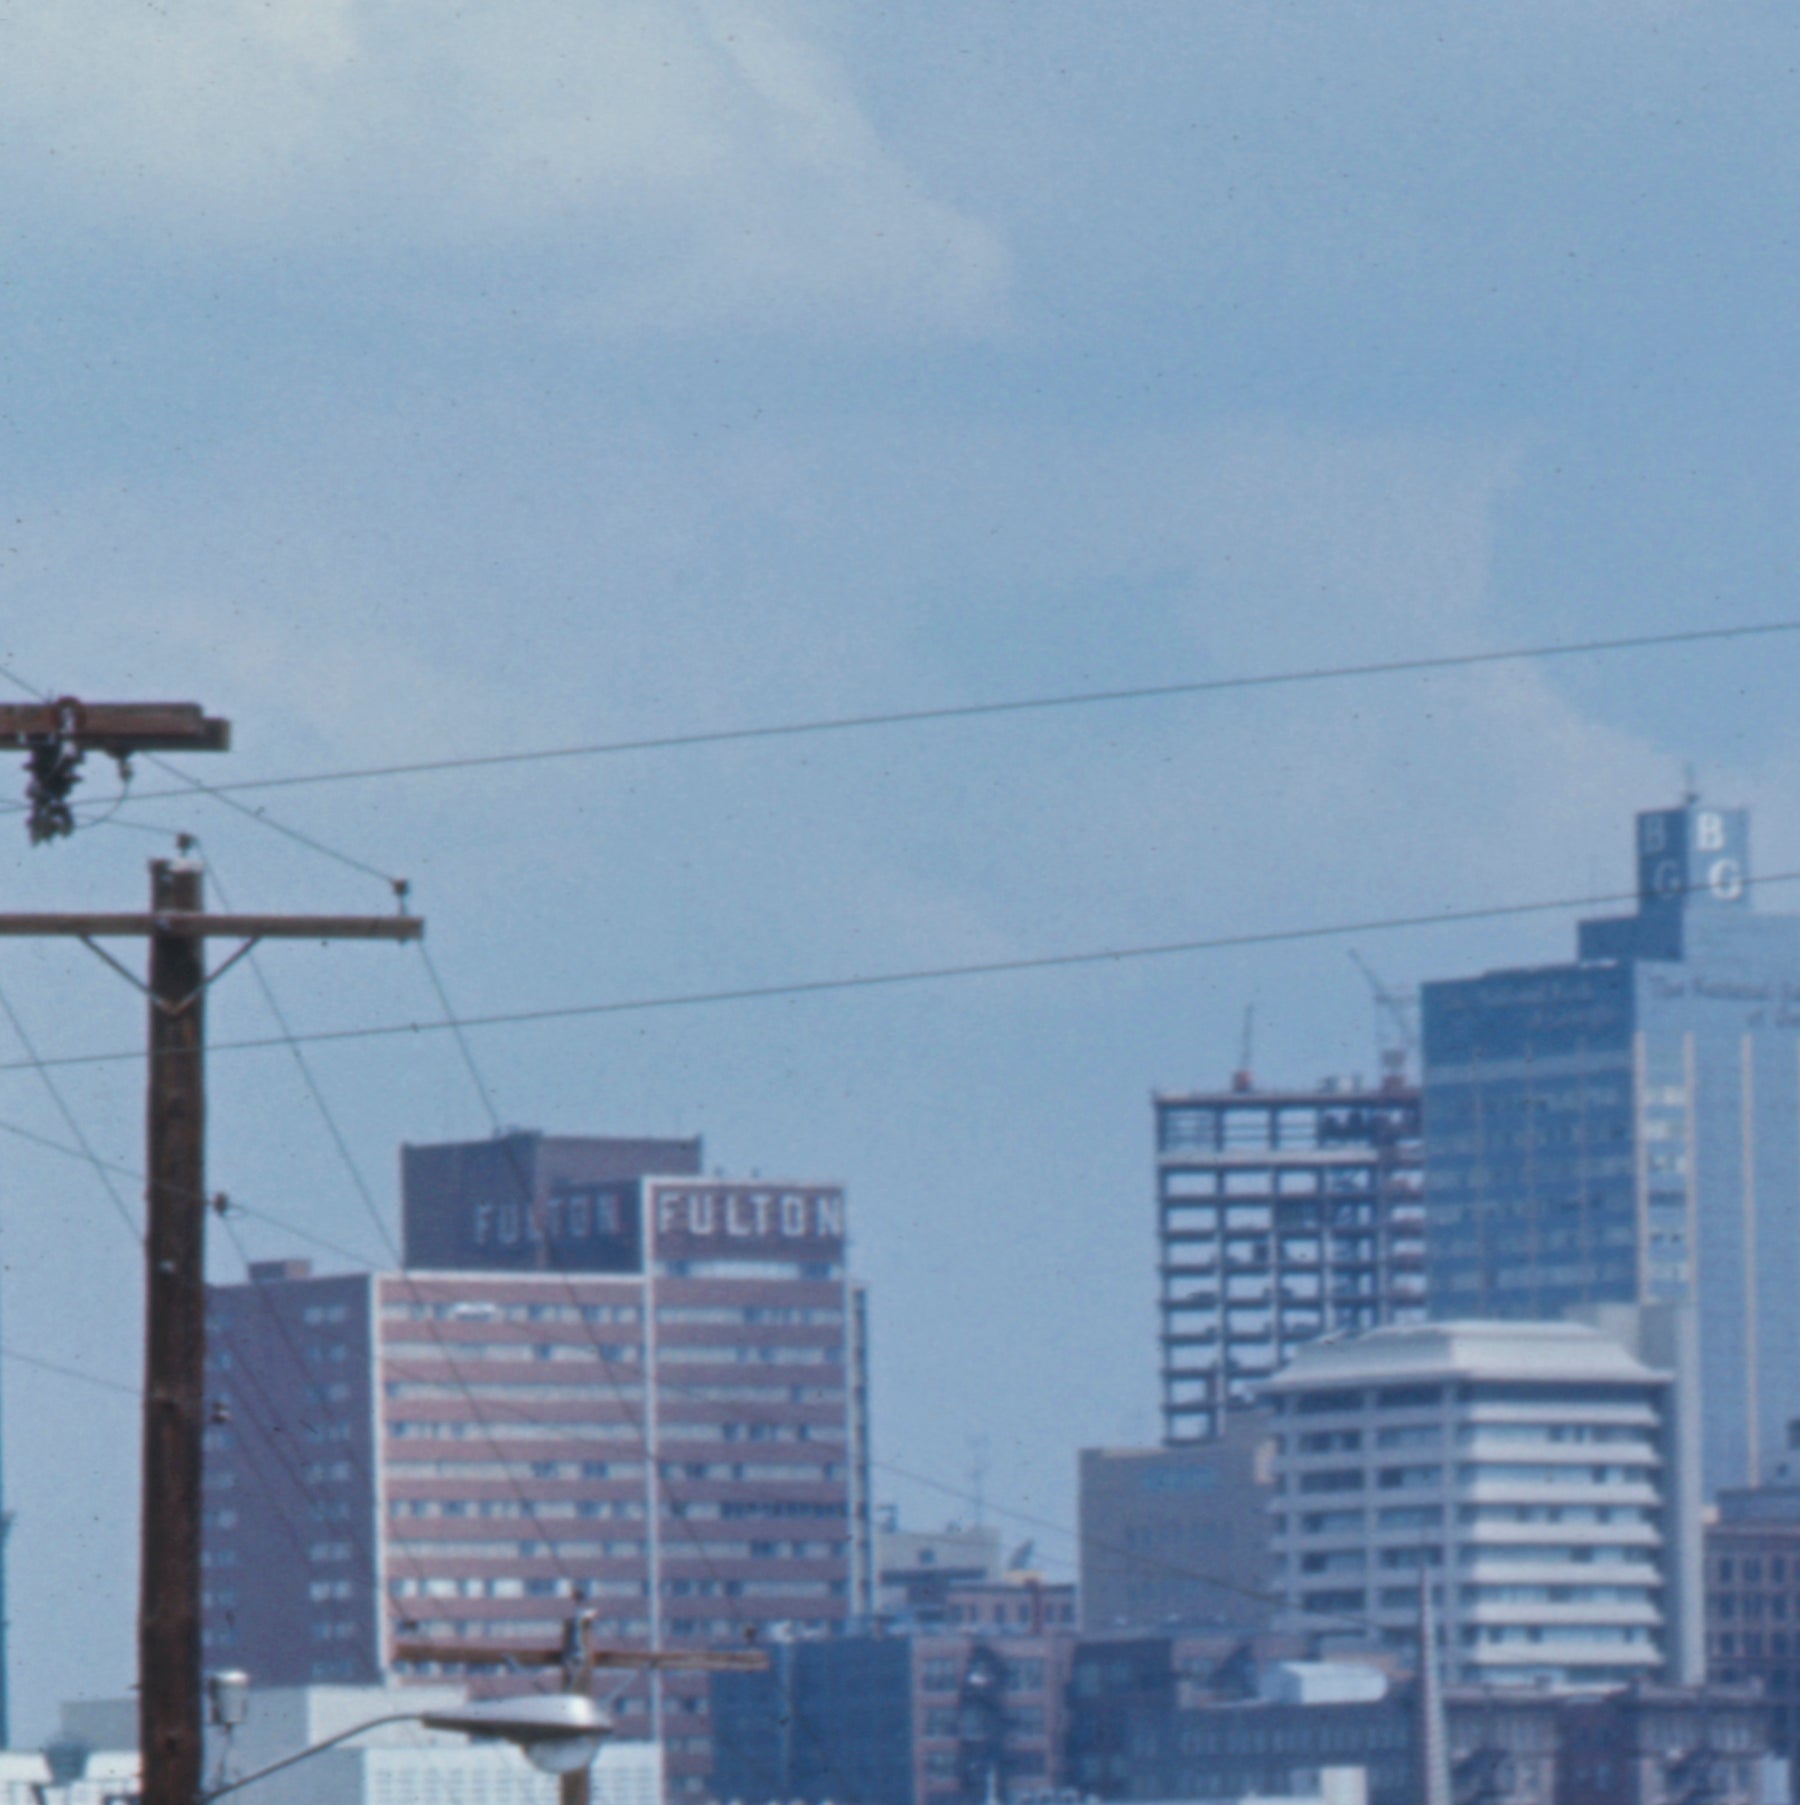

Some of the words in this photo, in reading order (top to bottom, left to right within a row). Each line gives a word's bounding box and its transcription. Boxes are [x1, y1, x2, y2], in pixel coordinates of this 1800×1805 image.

[1697, 812, 1725, 851] B
[1707, 858, 1743, 900] G
[474, 1195, 620, 1244] FULTON
[658, 1193, 842, 1236] FULTON
